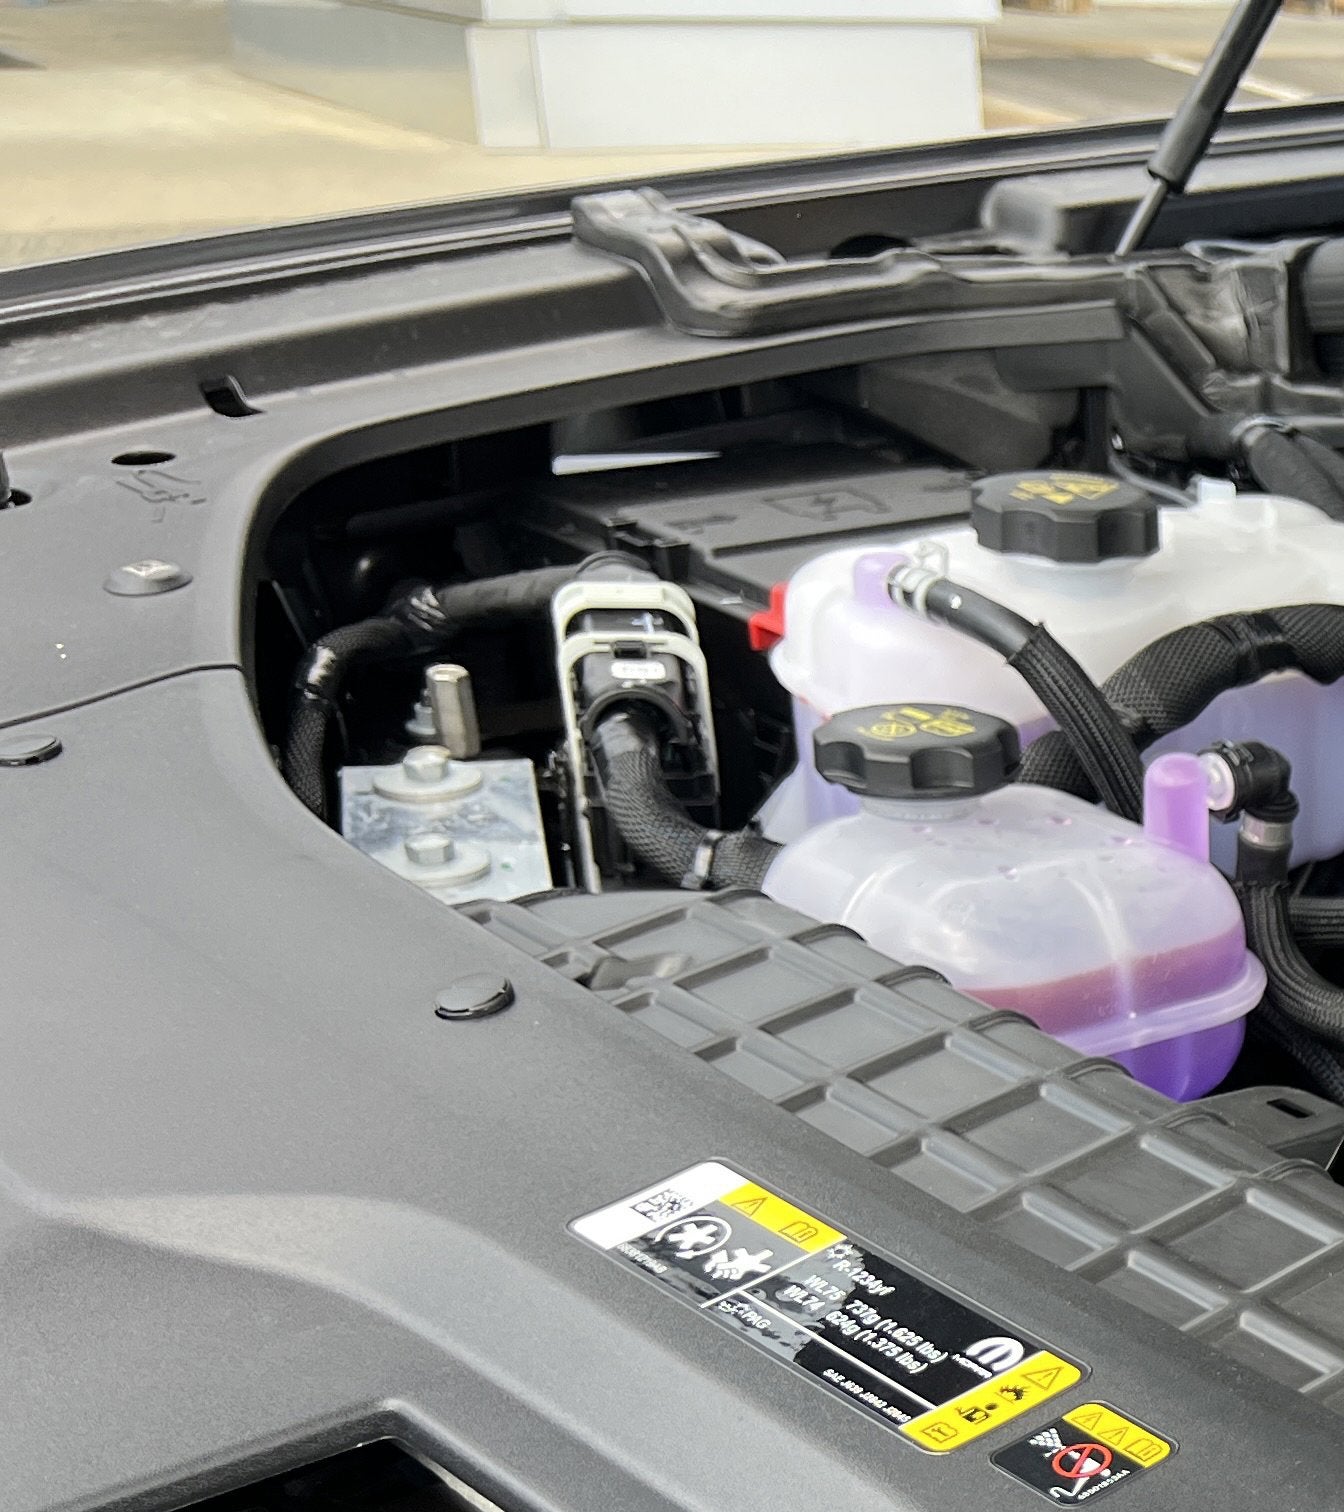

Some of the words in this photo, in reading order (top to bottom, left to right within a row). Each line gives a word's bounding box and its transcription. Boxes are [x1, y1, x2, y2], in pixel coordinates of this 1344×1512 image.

[833, 1259, 896, 1296] R-1234yf
[741, 1311, 772, 1329] PAG
[783, 1285, 826, 1312] WL74
[825, 1310, 861, 1336] 624g
[854, 1329, 903, 1357] (1.375
[895, 1352, 929, 1374] lbs)
[804, 1275, 846, 1300] WL75
[846, 1300, 881, 1325] 737g
[873, 1318, 923, 1347] (1.625
[915, 1341, 949, 1364] lbs)
[822, 1368, 845, 1384] SAE
